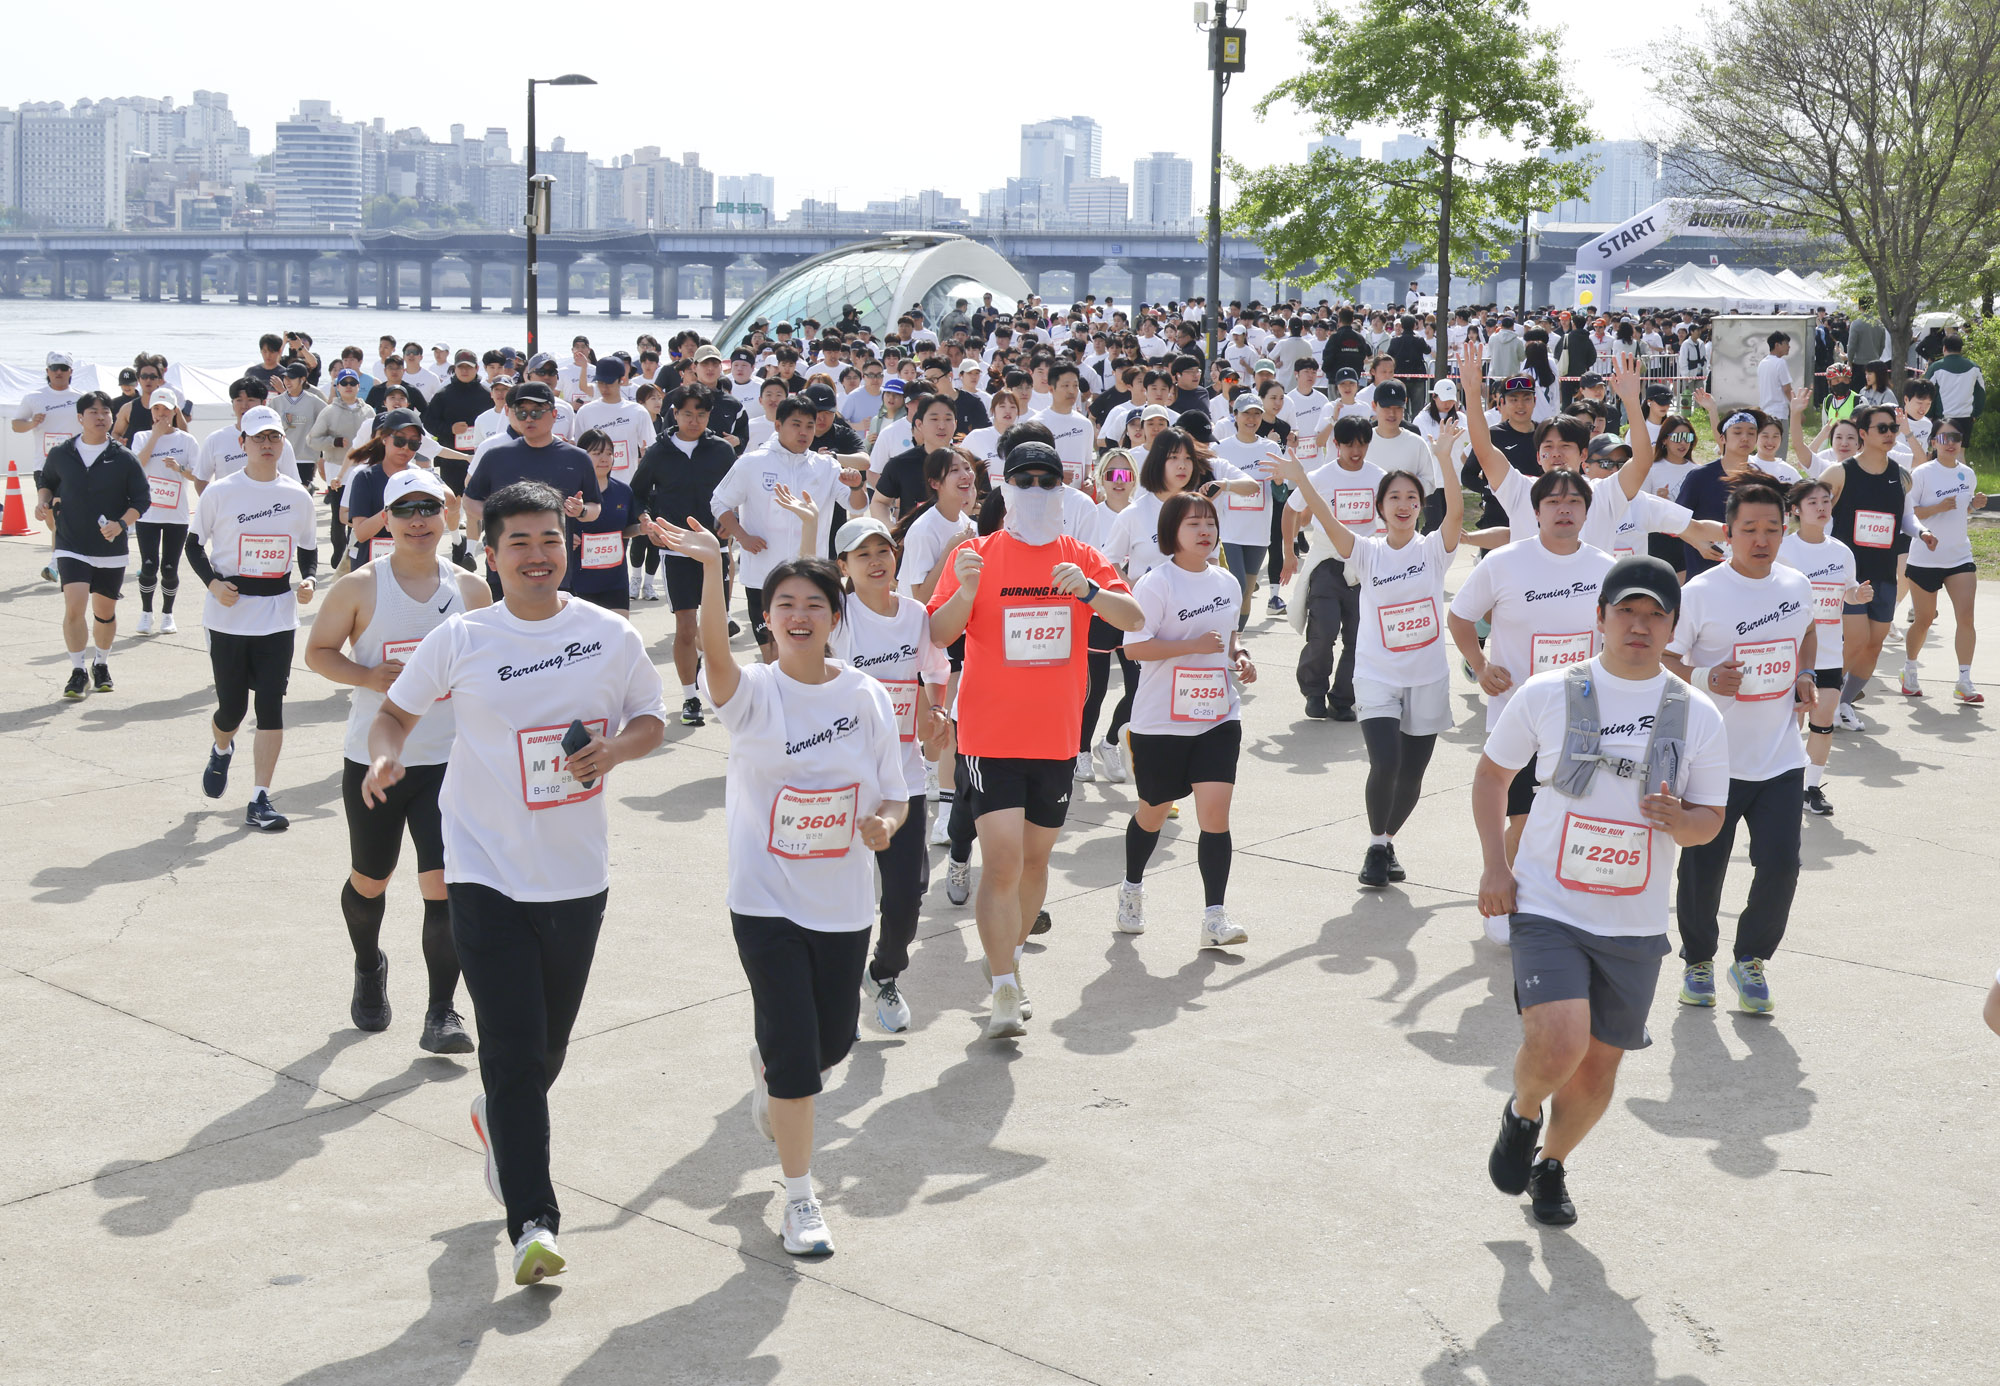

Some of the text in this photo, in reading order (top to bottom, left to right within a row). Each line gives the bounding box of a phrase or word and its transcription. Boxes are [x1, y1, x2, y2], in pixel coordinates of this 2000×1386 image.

[1598, 216, 1656, 259] START
[224, 452, 248, 462] Burnin
[1240, 463, 1254, 471] ning
[154, 488, 175, 497] 3045
[1348, 501, 1371, 510] 1979
[237, 503, 291, 524] Burning Run
[1867, 524, 1890, 534] 1084
[255, 549, 285, 559] 1382
[594, 544, 618, 554] 3551
[1371, 561, 1426, 587] Burning Run
[1805, 563, 1845, 580] urning Run
[1000, 587, 1050, 597] BURNING
[1524, 582, 1598, 602] Burning Run
[1178, 596, 1231, 622] Burning Run
[1387, 616, 1431, 632] W 3228
[1735, 600, 1801, 636] Burning Run
[1011, 627, 1065, 640] M 1827
[1539, 650, 1586, 664] M 1345
[1739, 647, 1766, 655] BURNING
[497, 641, 603, 682] Burning Run
[853, 652, 901, 669] Burning
[1742, 660, 1791, 676] M 1309
[1179, 687, 1225, 699] W 3354
[893, 703, 912, 716] 27
[1193, 708, 1215, 716] C-251
[833, 715, 860, 735] Run
[1600, 722, 1637, 737] ning
[526, 733, 563, 745] BURNING
[532, 760, 546, 772] M
[534, 785, 561, 795] B-102
[782, 794, 816, 804] BURNING
[781, 812, 848, 830] W 3604
[1573, 821, 1608, 834] BURNING
[1607, 828, 1625, 837] RUN
[777, 839, 808, 851] C-117
[1571, 844, 1641, 866] M 2205
